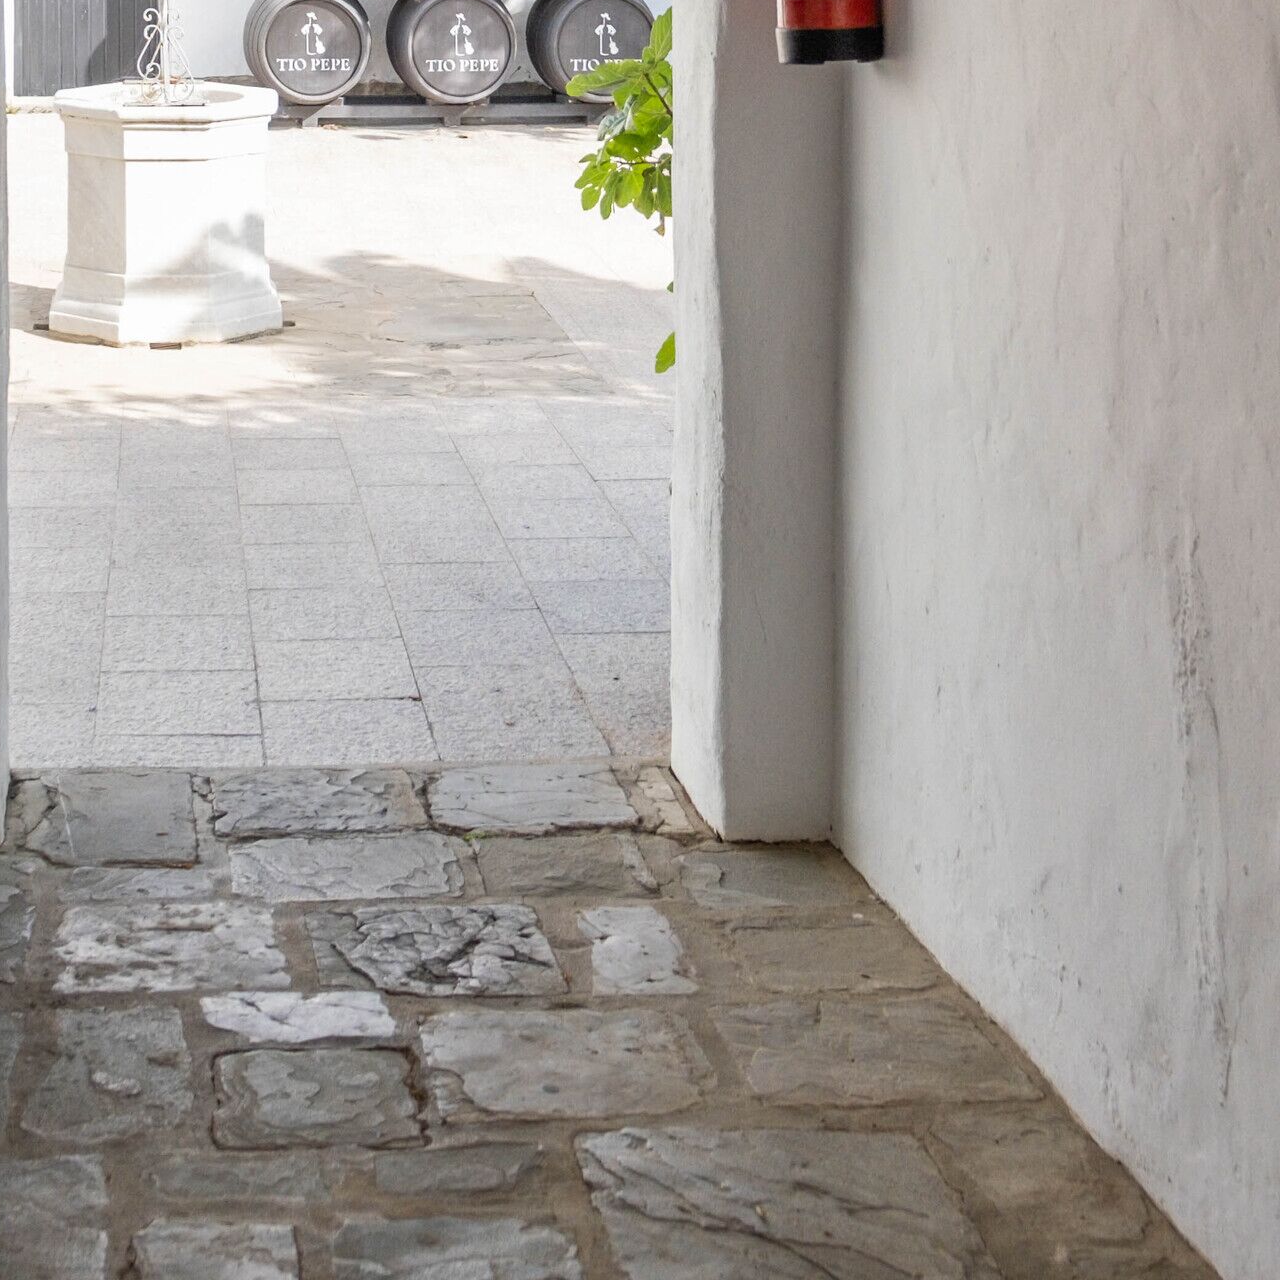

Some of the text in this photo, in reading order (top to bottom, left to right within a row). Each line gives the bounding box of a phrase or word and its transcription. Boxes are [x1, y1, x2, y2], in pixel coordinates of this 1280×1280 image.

[276, 58, 351, 71] TIO PEPE
[425, 59, 499, 72] TIO PEPE
